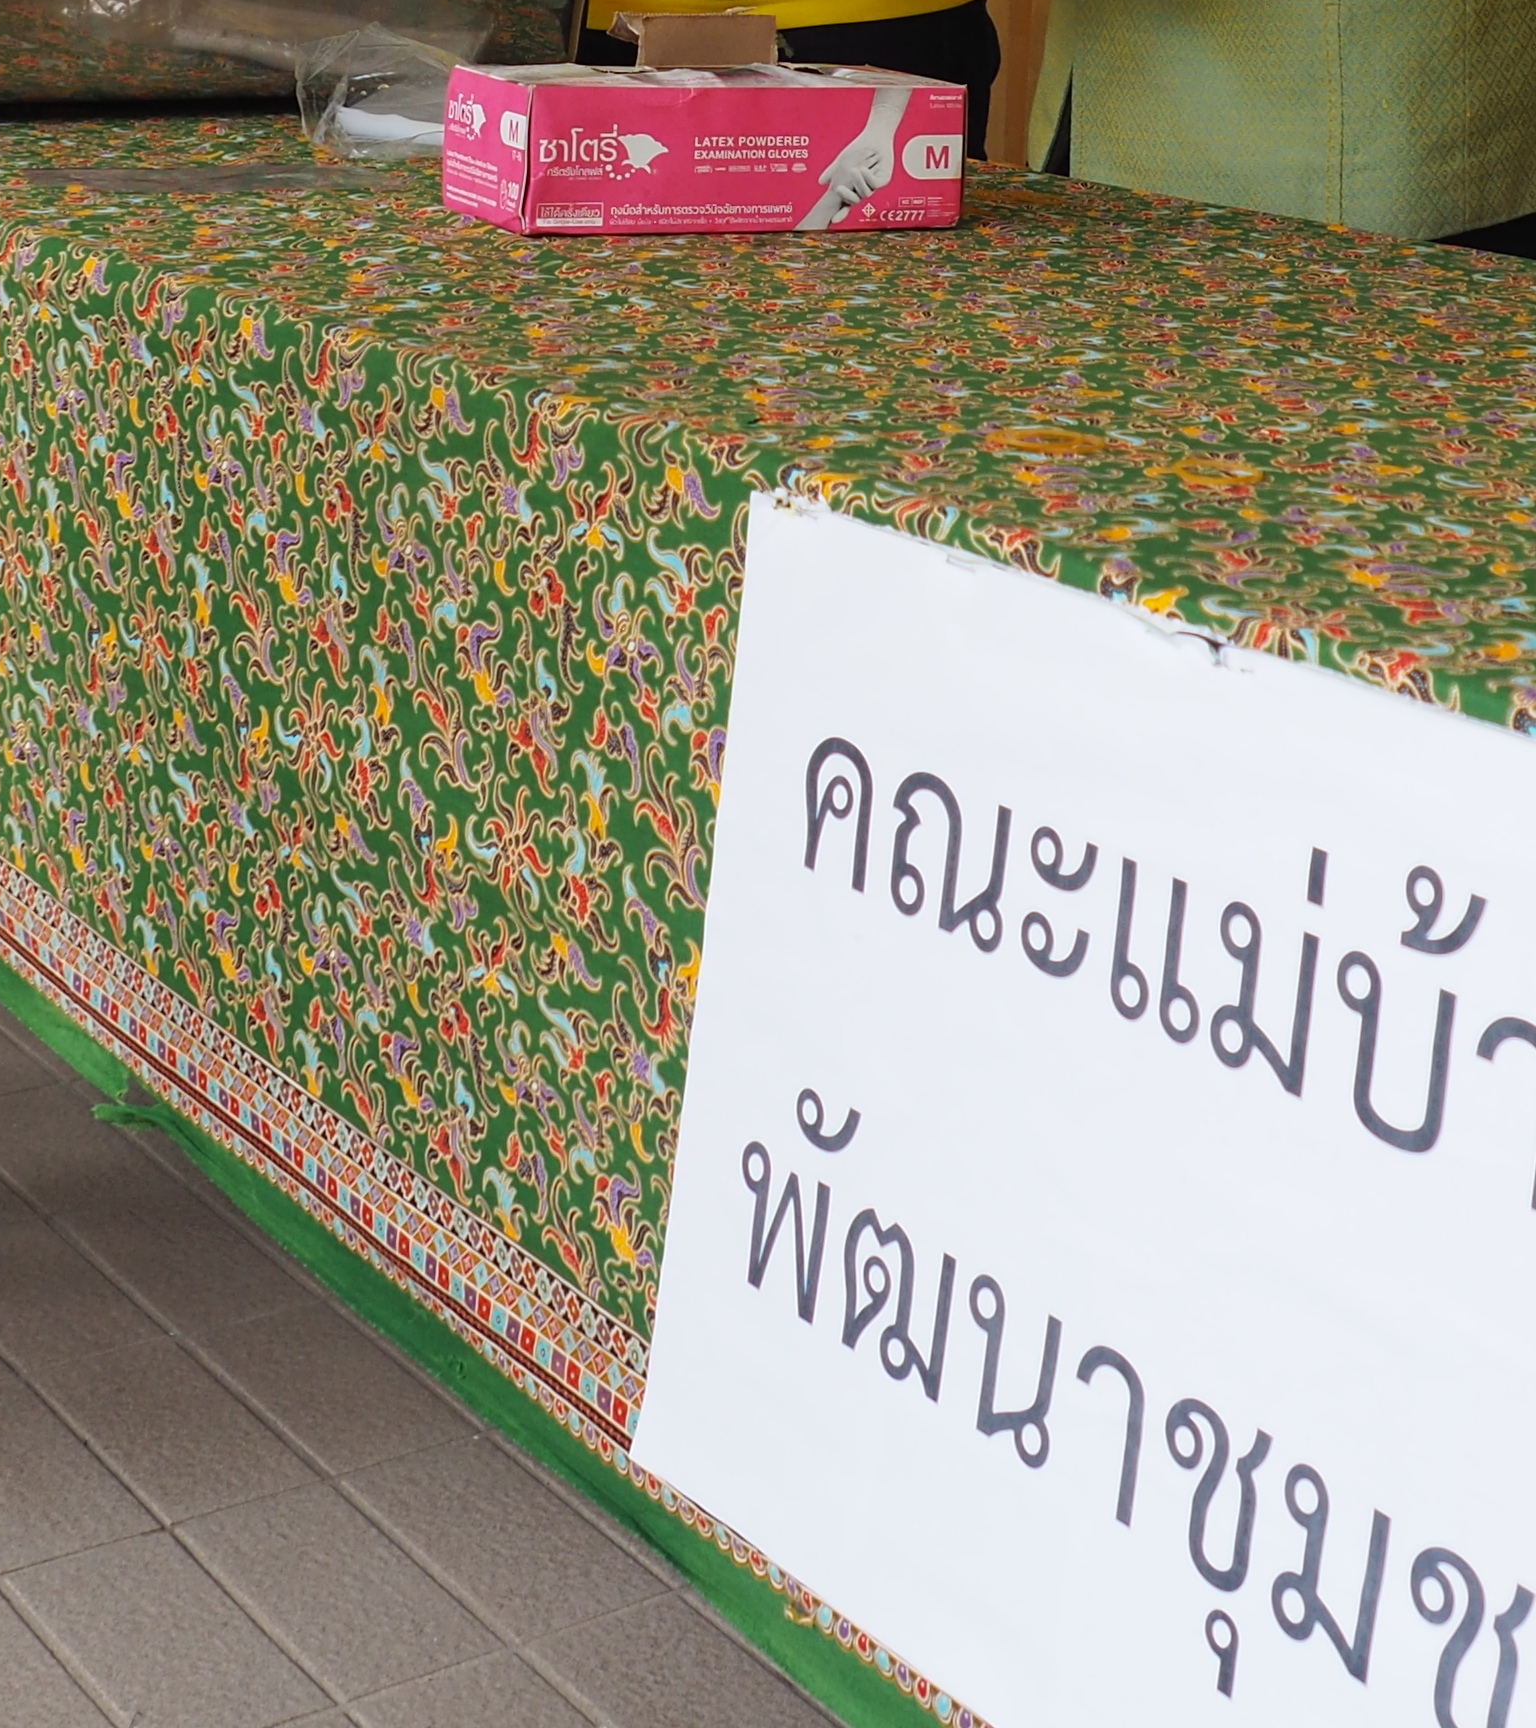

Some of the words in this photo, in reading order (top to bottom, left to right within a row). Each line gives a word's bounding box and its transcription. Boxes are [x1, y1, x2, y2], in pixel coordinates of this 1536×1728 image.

[508, 119, 520, 144] M
[538, 123, 618, 163] ซาโตรี่
[694, 136, 735, 147] LATEX
[738, 135, 810, 147] POWDERED
[694, 150, 765, 160] EXAMINATION
[768, 149, 809, 159] GLOVES
[925, 145, 950, 170] M
